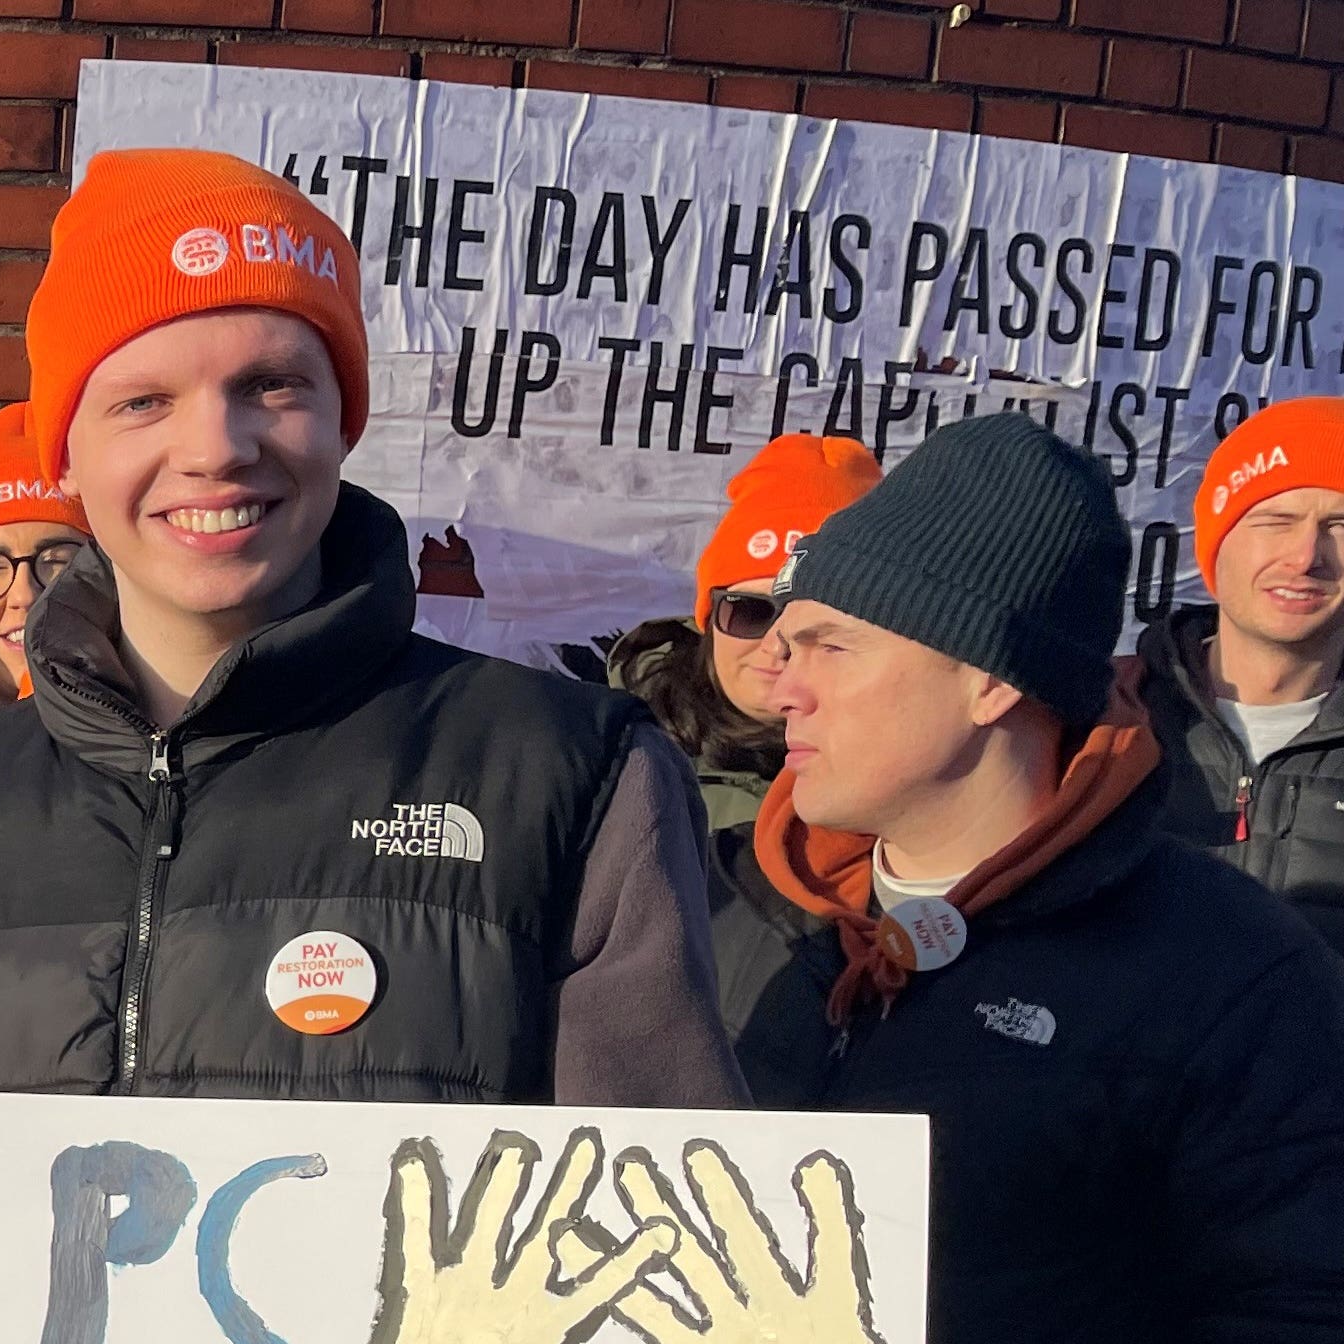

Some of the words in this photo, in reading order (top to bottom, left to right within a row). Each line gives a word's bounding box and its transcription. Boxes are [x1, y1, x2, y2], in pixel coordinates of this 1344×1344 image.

[241, 223, 339, 284] BMA
[524, 185, 693, 305] DAY
[714, 200, 872, 324] HAS
[900, 221, 1181, 352] PASSED
[1202, 255, 1323, 369] FOR
[451, 326, 561, 438] UP
[598, 336, 744, 456] THE
[769, 352, 1191, 490] CAPIST
[1229, 445, 1289, 495] BMA
[392, 803, 443, 821] THE
[351, 819, 442, 838] NORTH
[375, 837, 441, 857] FACE
[302, 942, 338, 959] PAY
[277, 957, 364, 973] RESTORATION
[298, 971, 344, 988] NOW
